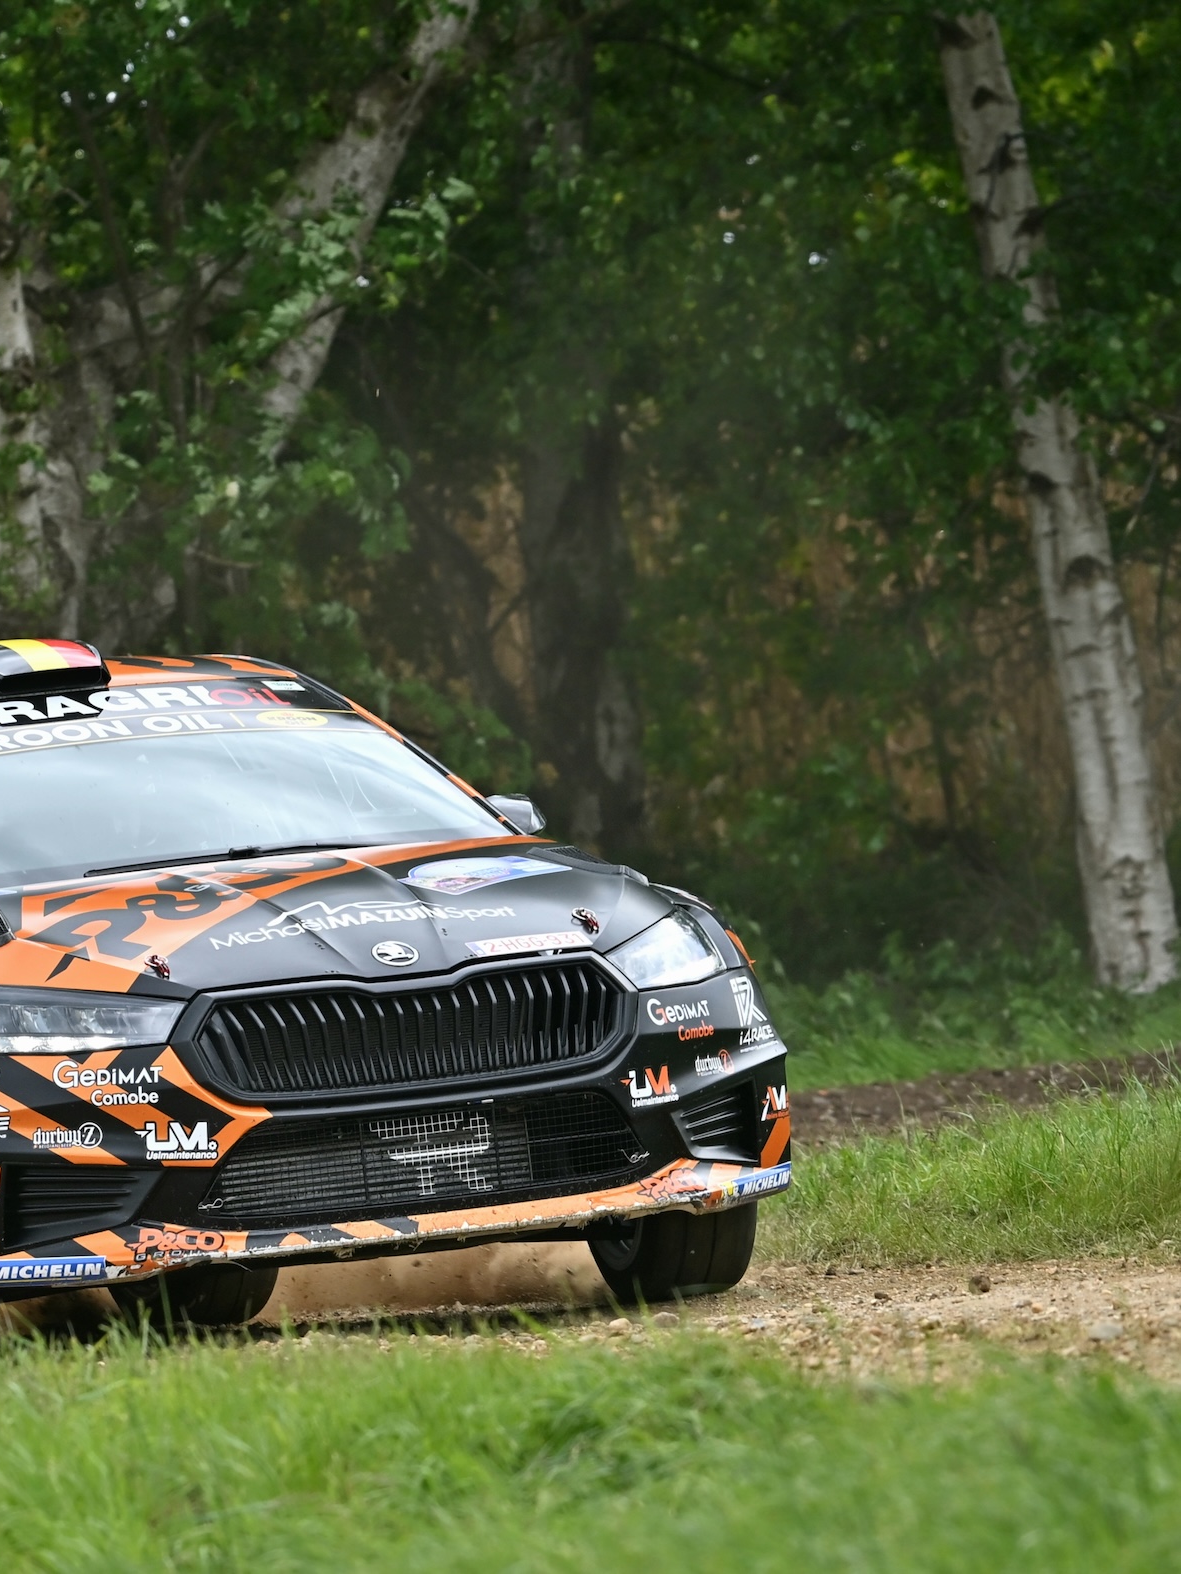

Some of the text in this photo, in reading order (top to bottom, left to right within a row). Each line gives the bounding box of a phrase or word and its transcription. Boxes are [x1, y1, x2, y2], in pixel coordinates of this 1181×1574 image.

[142, 714, 224, 733] OIL
[482, 931, 586, 954] 2-HGG-931
[678, 1020, 715, 1042] Comobe
[90, 1089, 160, 1107] Comobe
[146, 1150, 218, 1161] Usimaintenance
[741, 1171, 791, 1197] MICHELIN
[137, 1228, 224, 1254] P&CO
